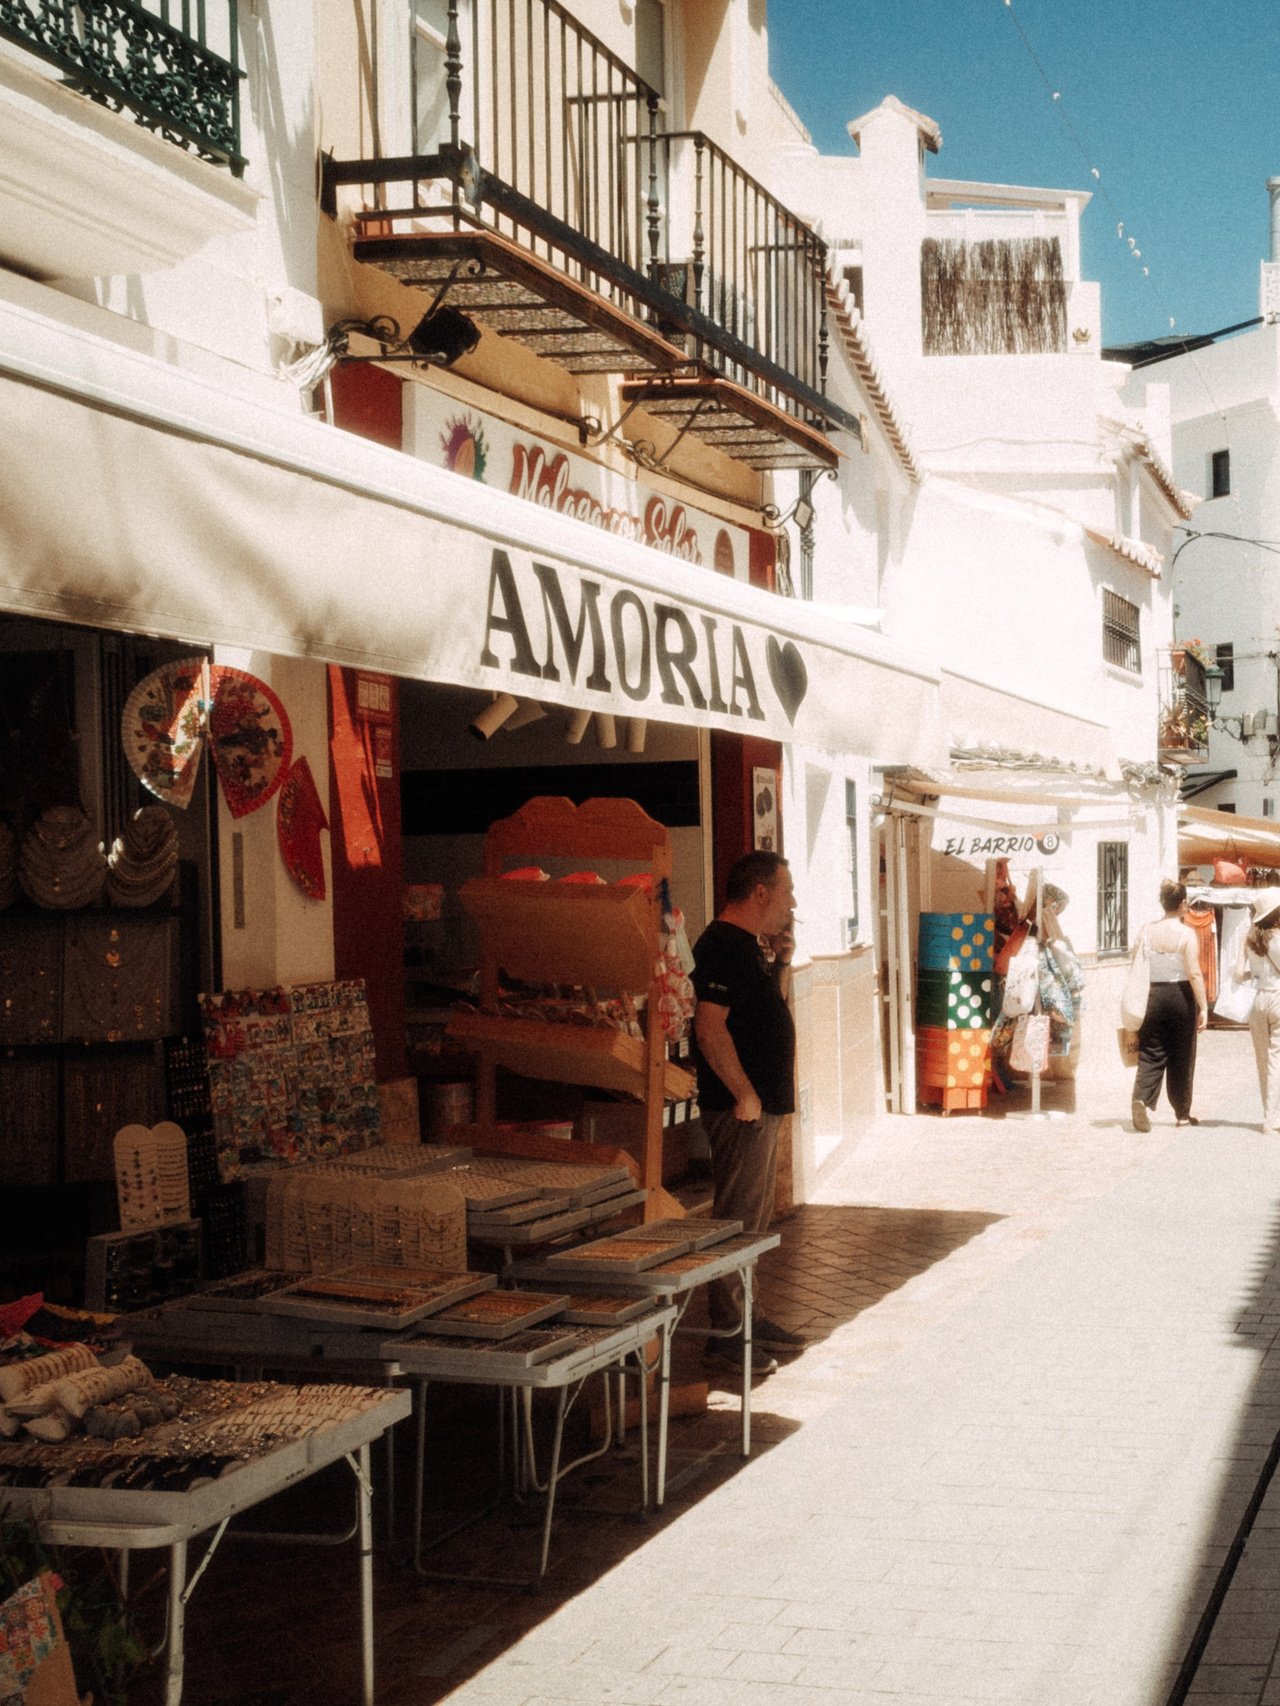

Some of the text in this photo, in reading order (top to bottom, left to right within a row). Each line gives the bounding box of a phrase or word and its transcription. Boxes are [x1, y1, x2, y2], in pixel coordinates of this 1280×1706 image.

[480, 547, 766, 722] AMORIA
[943, 837, 966, 857] EL
[968, 836, 1035, 857] BARRIO
